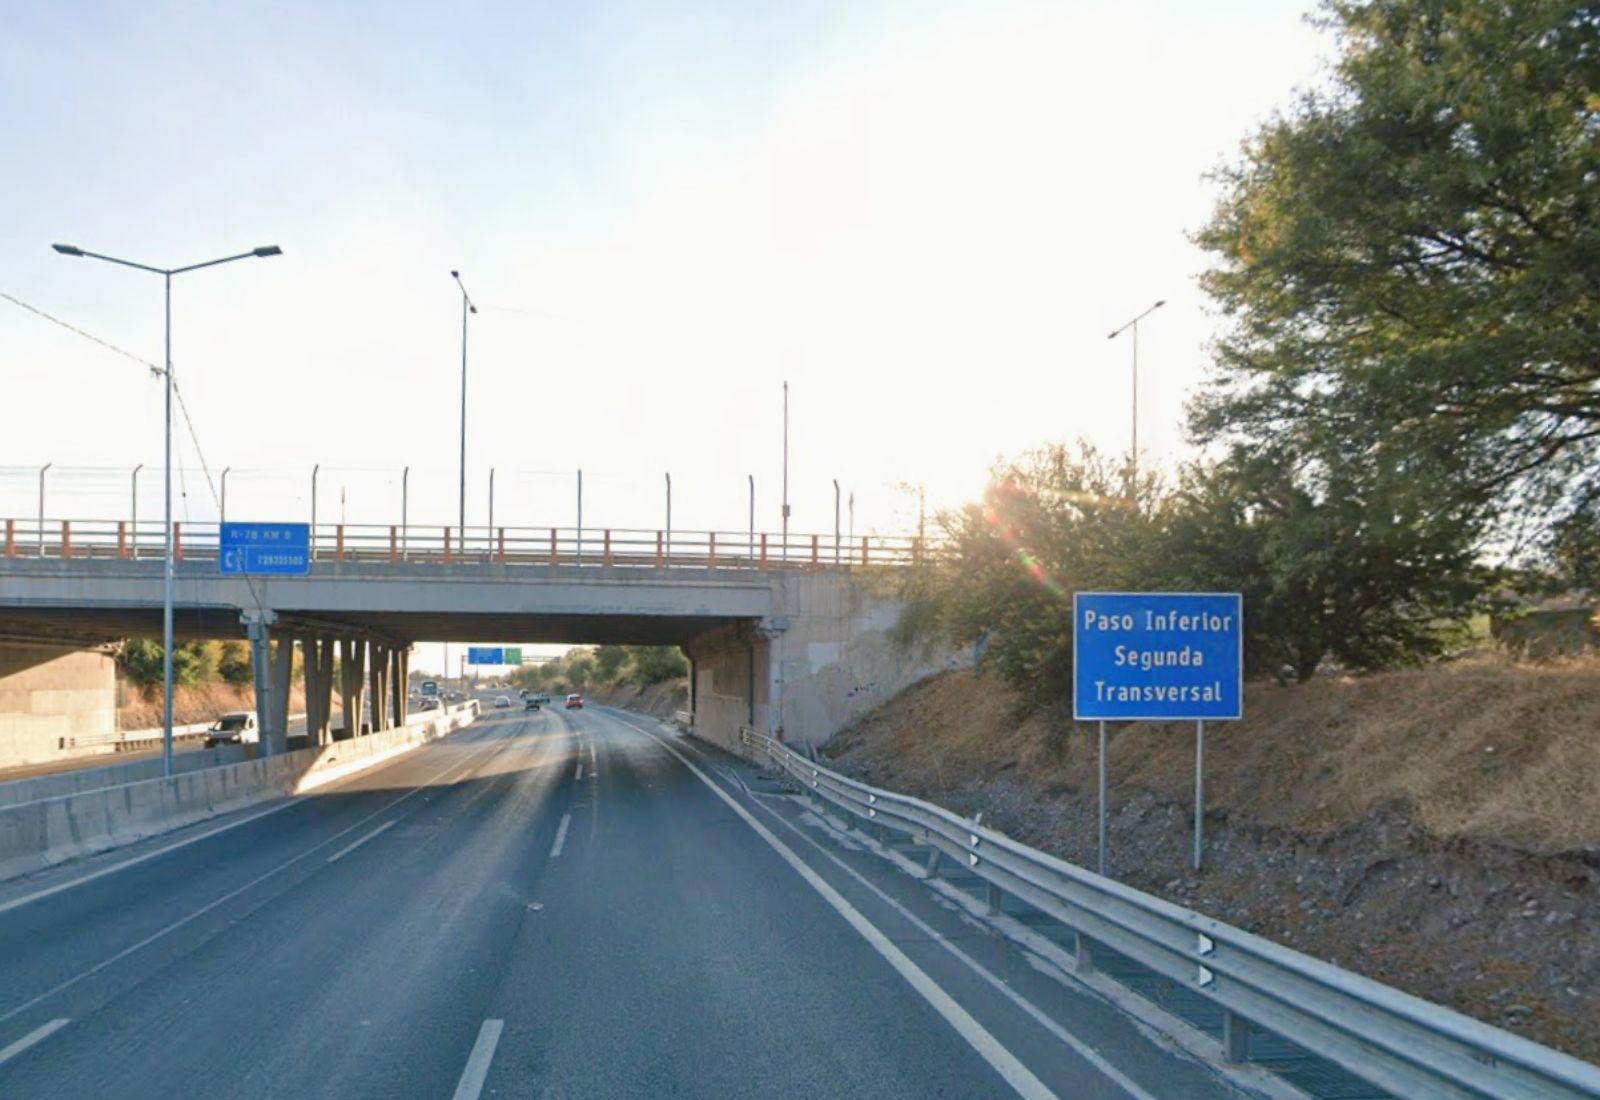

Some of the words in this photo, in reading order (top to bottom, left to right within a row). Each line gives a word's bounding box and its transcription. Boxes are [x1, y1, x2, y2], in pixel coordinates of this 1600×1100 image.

[1084, 610, 1134, 631] Paso
[1145, 610, 1232, 631] Inferior
[1114, 645, 1204, 671] Segunda
[1095, 681, 1222, 702] Transversal
